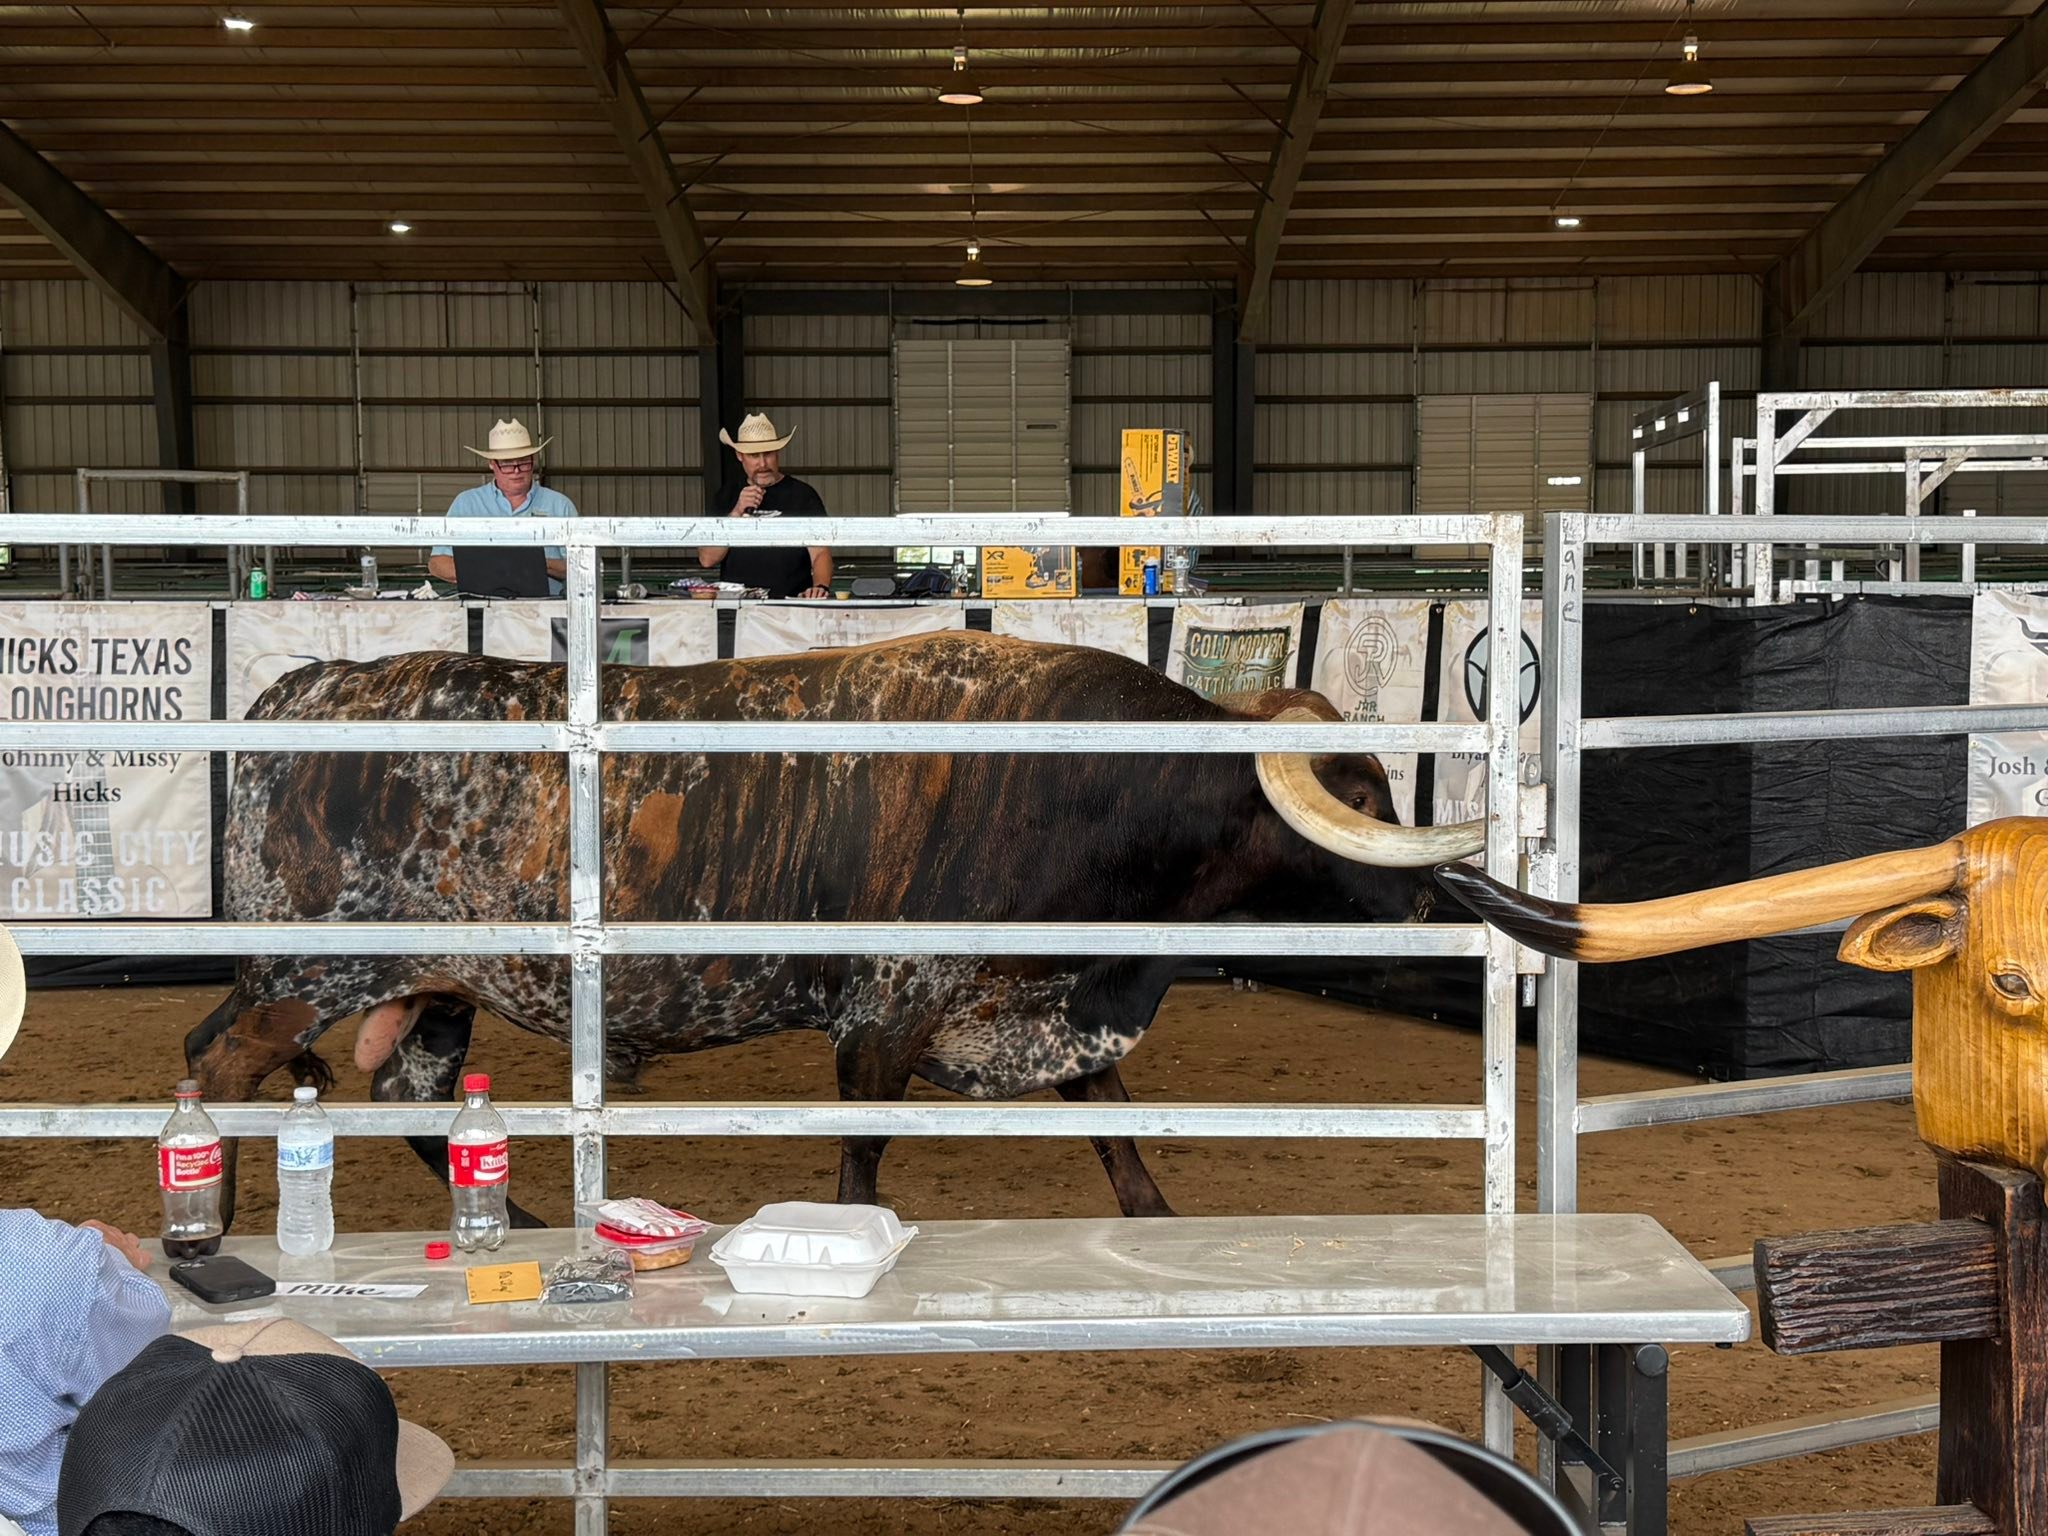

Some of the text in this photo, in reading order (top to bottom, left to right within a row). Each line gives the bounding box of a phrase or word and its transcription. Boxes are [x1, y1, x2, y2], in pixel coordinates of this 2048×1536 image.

[986, 550, 1005, 561] XR
[0, 637, 192, 675] ICKS TEXAS
[1189, 632, 1286, 660] COLD COPPER
[0, 686, 183, 720] ONGHORNS
[0, 750, 182, 774] ohnny & Missy
[1989, 756, 2036, 778] Josh
[53, 781, 122, 802] Hicks
[0, 831, 202, 868] USIC CITY
[11, 877, 166, 914] CLASSIC
[287, 1283, 385, 1297] Mike
